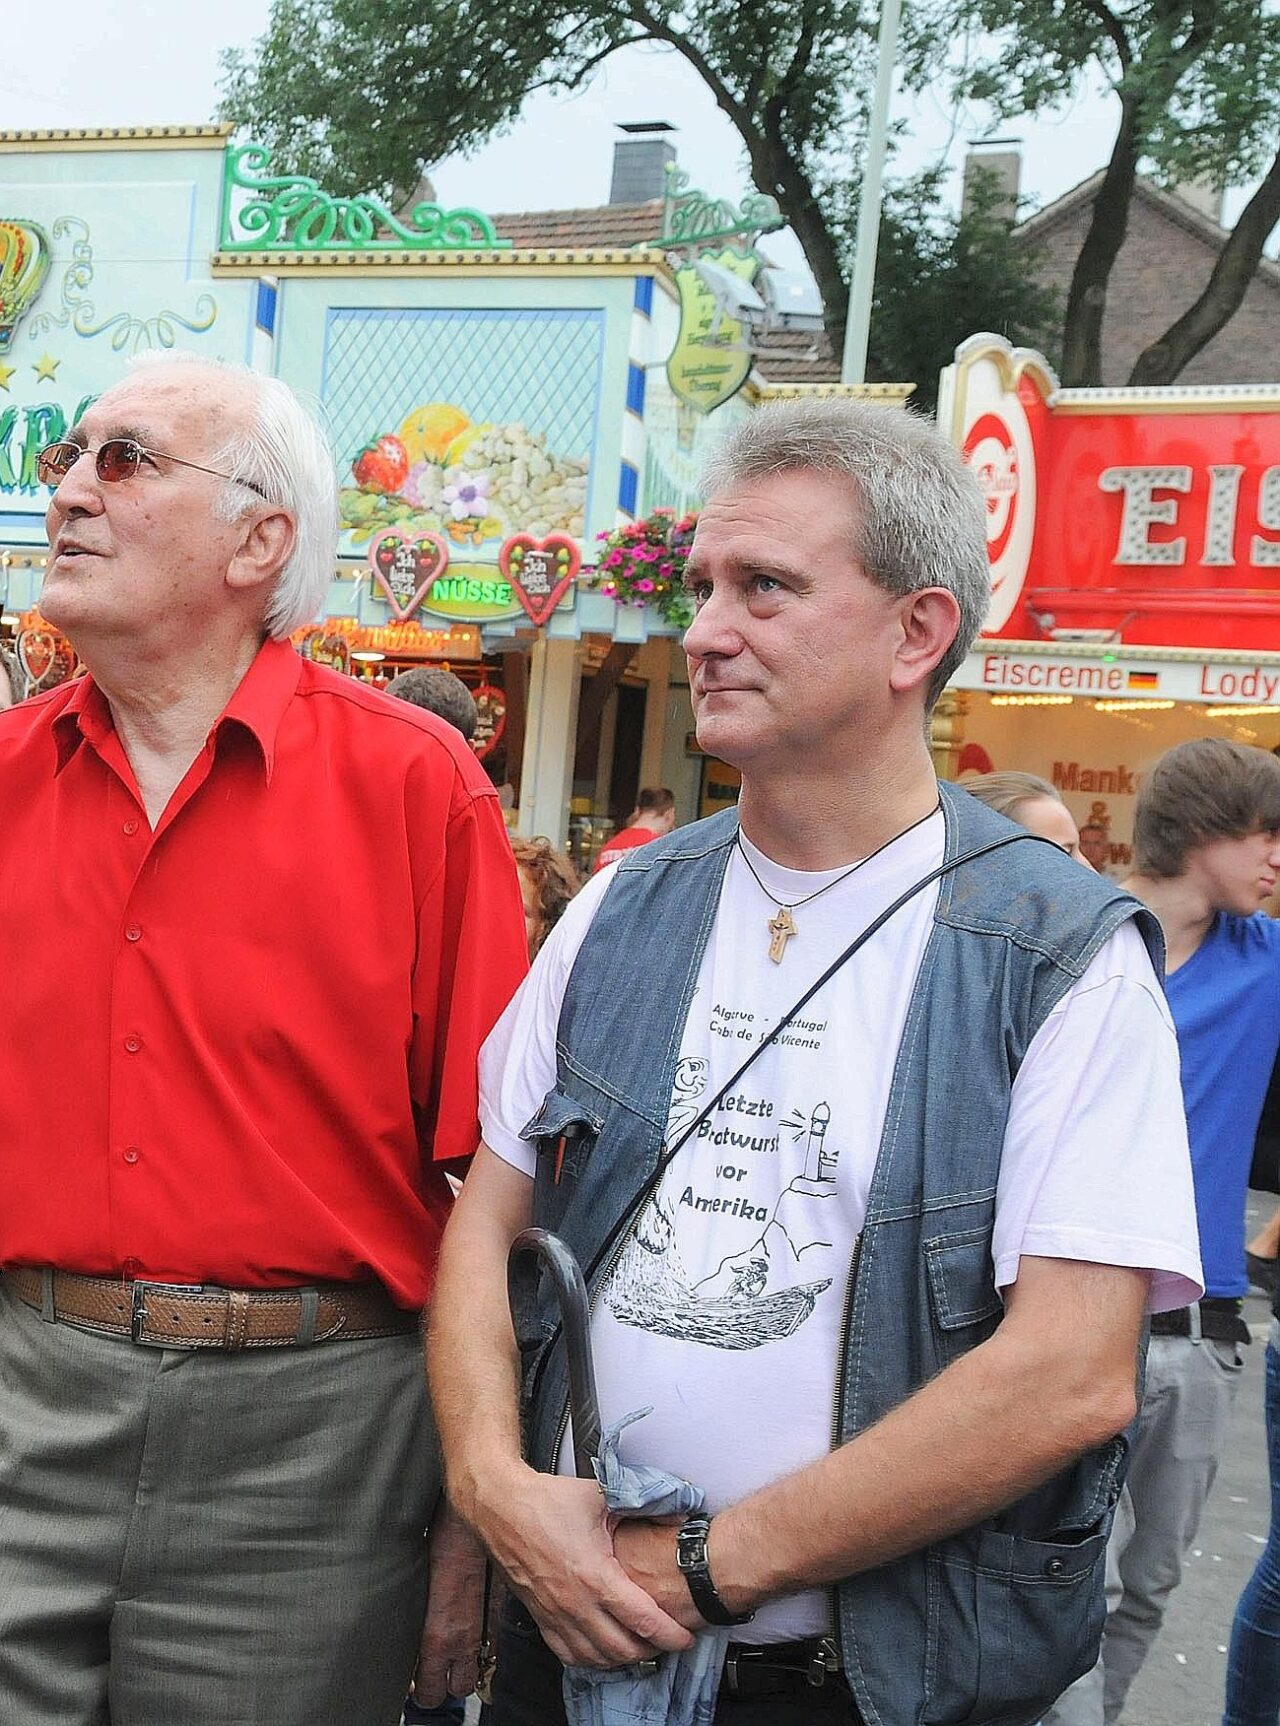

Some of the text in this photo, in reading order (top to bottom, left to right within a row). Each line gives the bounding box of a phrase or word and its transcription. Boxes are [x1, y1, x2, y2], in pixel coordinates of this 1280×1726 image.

[432, 574, 513, 607] NÜSSE
[982, 655, 1279, 702] Eiscreme Lody
[736, 1028, 753, 1041] de
[758, 1031, 779, 1046] So
[780, 1034, 821, 1050] Vicente
[716, 1092, 774, 1118] Letzte
[715, 1164, 748, 1182] vor
[679, 1185, 769, 1222] Amerika
